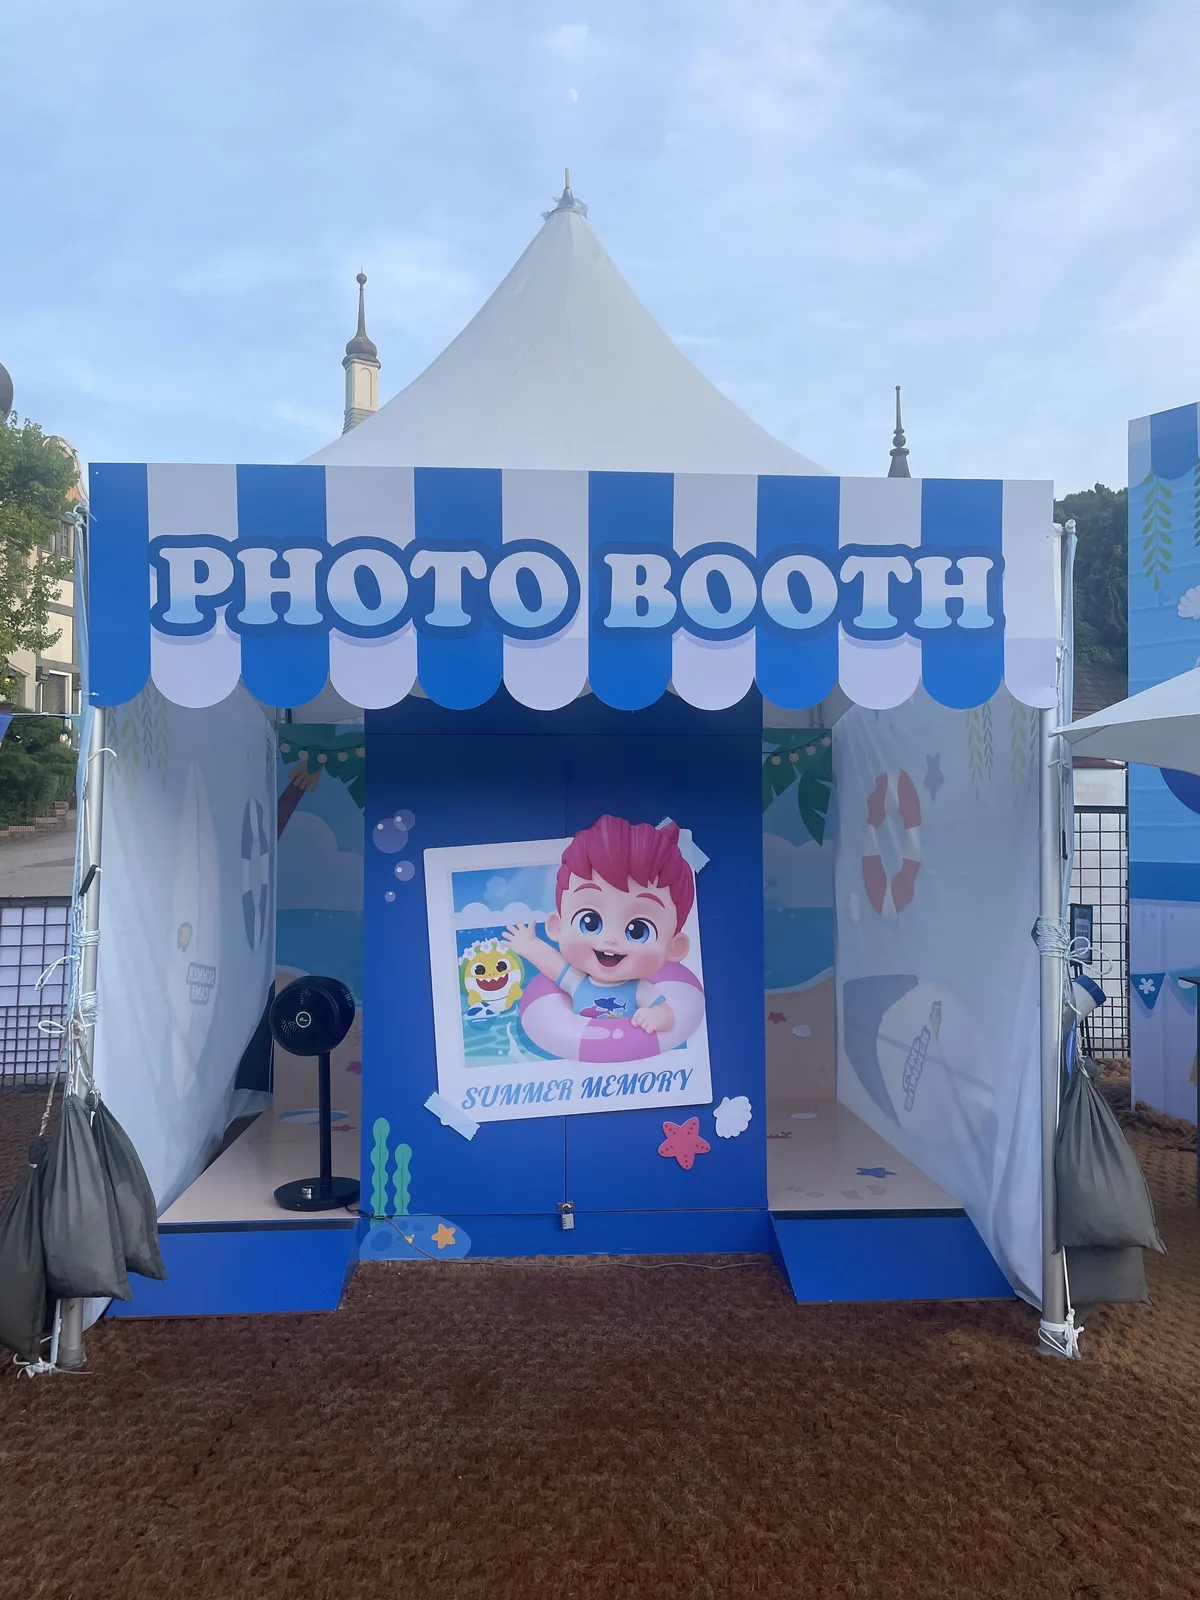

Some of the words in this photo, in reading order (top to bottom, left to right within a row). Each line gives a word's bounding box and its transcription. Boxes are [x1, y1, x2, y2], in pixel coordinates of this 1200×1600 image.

[158, 546, 569, 628] PHOTO
[603, 553, 995, 630] BOOTH
[461, 1078, 574, 1110] SUMMER
[580, 1068, 694, 1099] MEMORY
